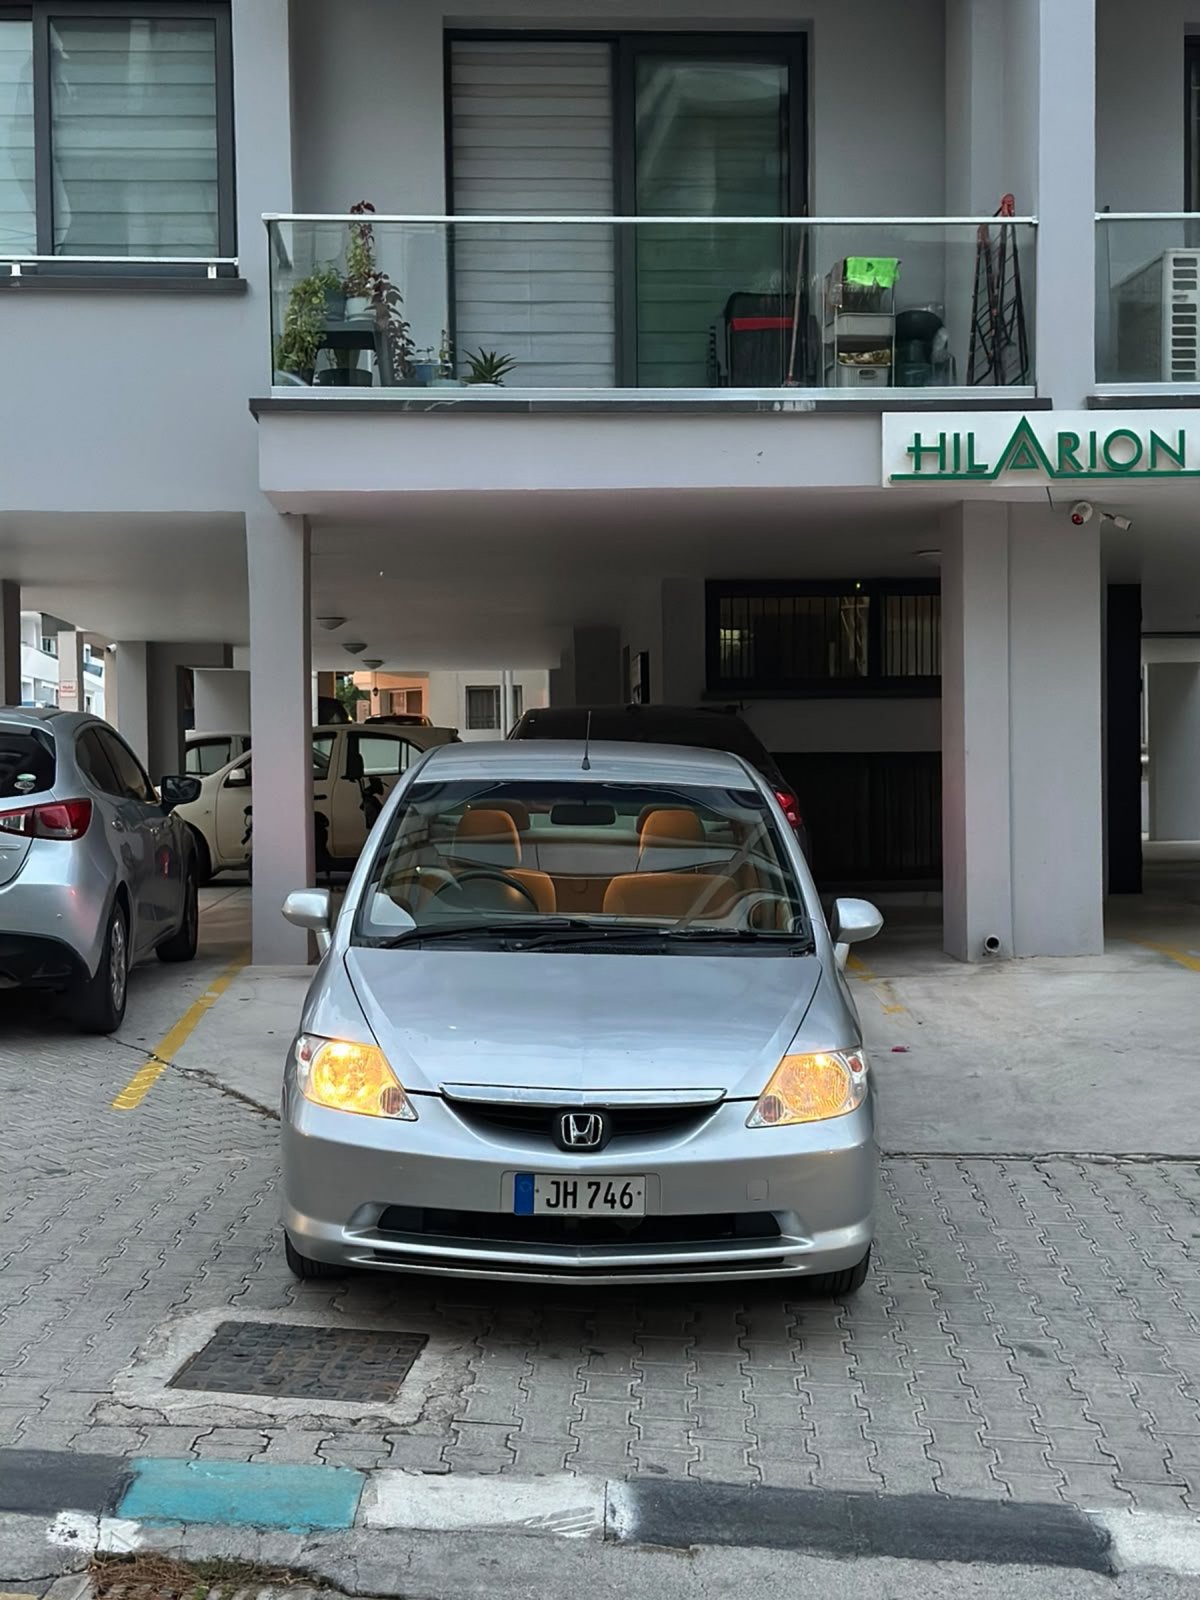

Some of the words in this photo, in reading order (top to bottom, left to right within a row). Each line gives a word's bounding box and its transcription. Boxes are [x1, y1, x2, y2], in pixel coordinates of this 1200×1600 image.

[907, 415, 1186, 475] HILARION
[545, 1180, 578, 1209] JH
[587, 1181, 634, 1210] 746
